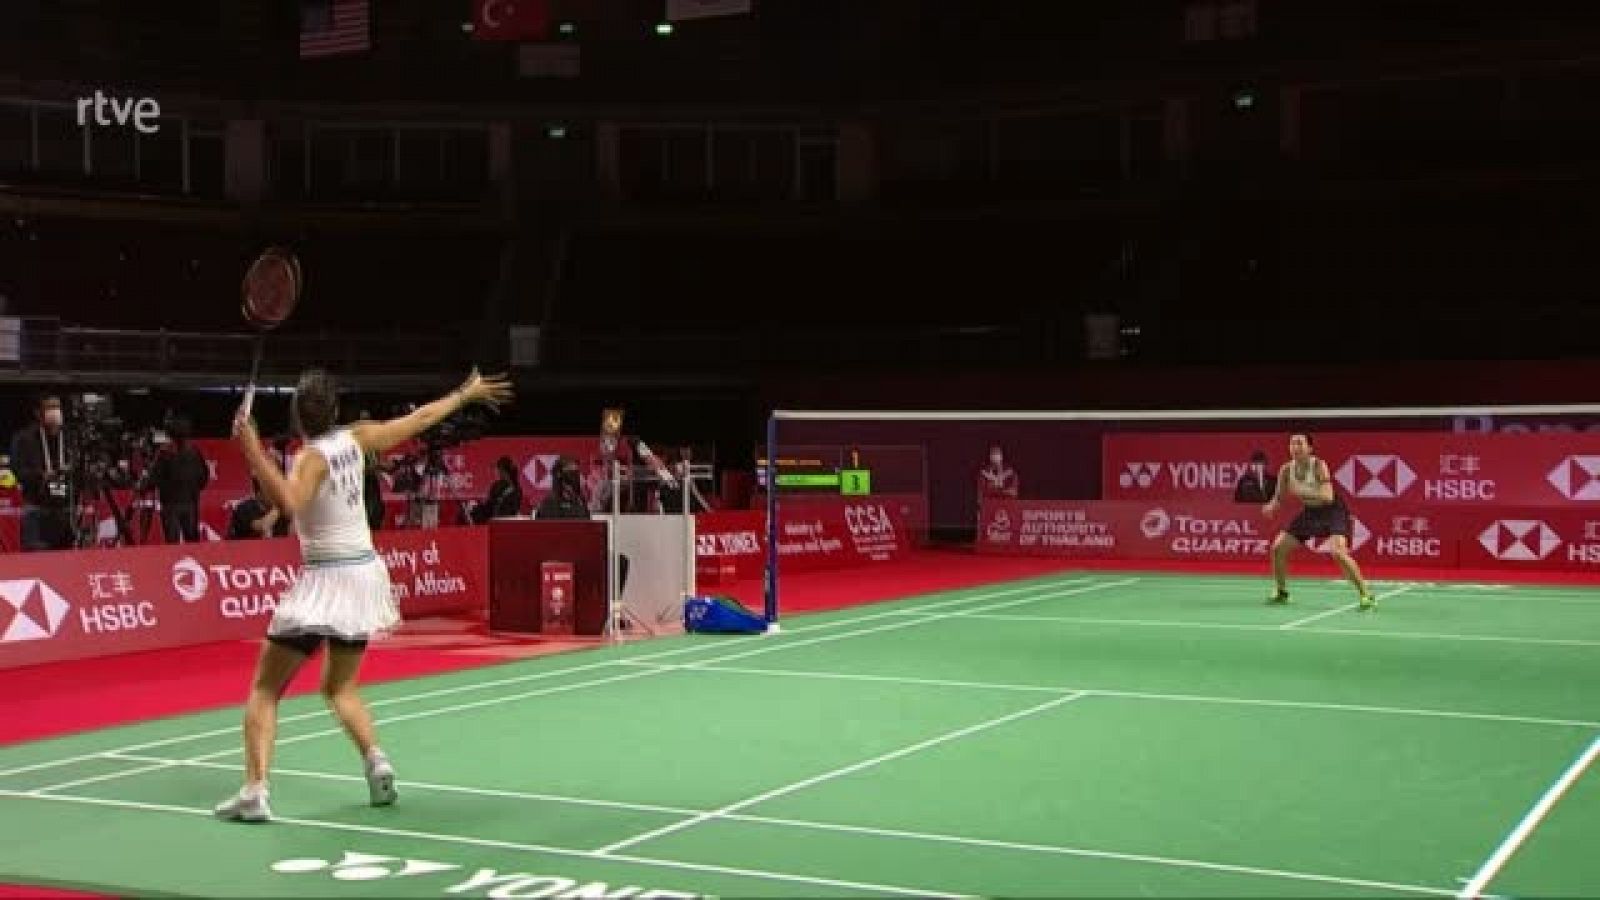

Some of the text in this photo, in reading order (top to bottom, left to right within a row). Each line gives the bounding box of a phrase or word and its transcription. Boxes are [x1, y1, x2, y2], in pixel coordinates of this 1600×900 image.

[1168, 462, 1249, 489] YONEX
[1424, 480, 1496, 500] HSBC
[845, 505, 893, 535] CCSA
[1174, 515, 1258, 536] TOTAL
[1171, 538, 1271, 554] QUARTZ
[1377, 538, 1440, 556] HSBC
[415, 570, 466, 596] Affairs
[79, 602, 158, 633] HSBC
